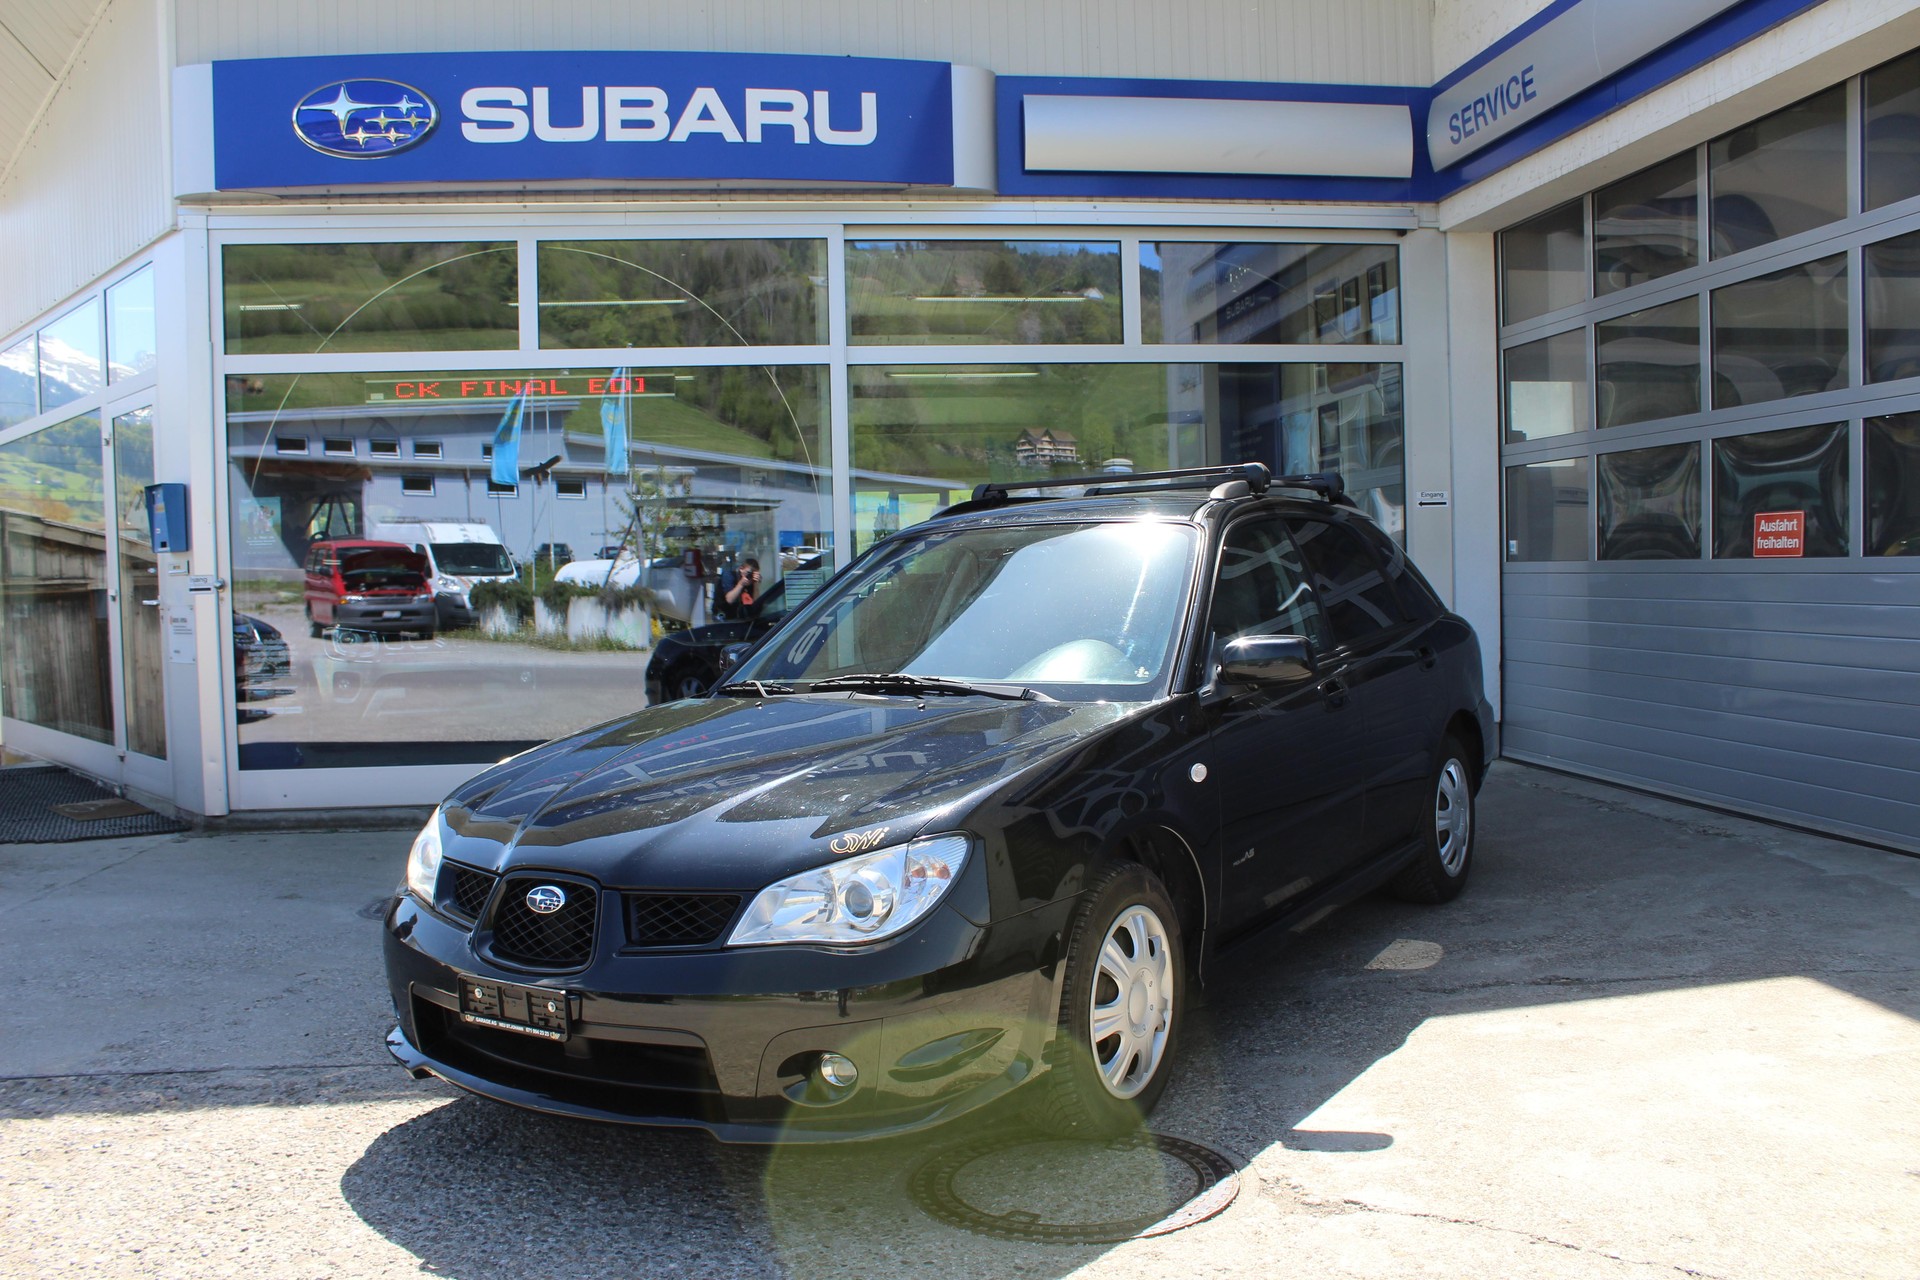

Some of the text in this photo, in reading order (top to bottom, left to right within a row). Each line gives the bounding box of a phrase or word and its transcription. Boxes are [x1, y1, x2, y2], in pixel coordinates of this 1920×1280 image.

[1448, 64, 1537, 145] SERVICE
[461, 86, 878, 146] SUBARU
[395, 382, 440, 399] CK
[461, 378, 568, 397] FINAL
[1420, 491, 1444, 499] Eingang
[1759, 519, 1798, 532] Ausfahrt
[1757, 536, 1799, 549] freihalten
